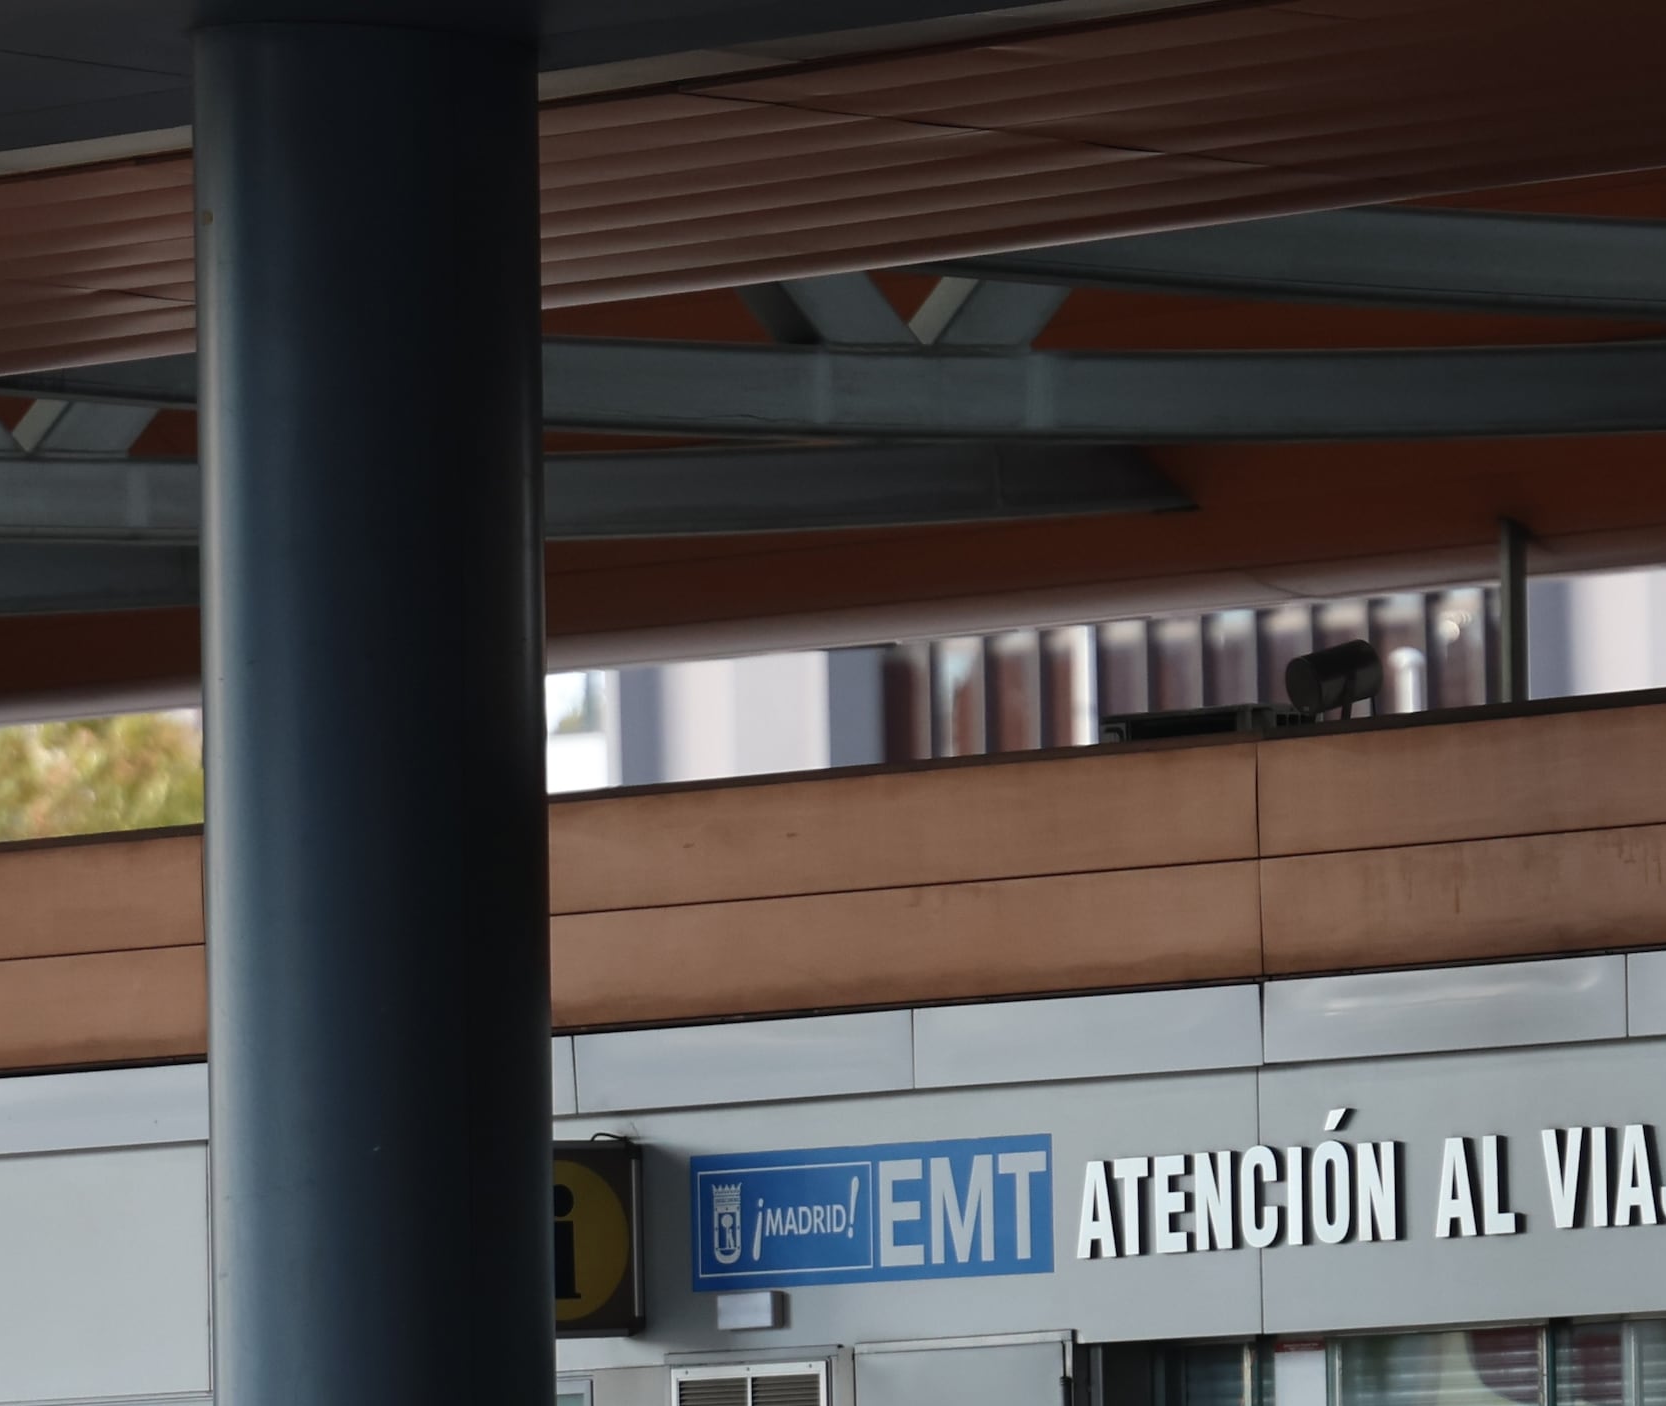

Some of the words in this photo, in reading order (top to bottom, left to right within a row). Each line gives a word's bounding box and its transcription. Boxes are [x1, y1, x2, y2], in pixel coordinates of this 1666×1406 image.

[753, 1176, 860, 1261] ¡MADRID!
[878, 1150, 1047, 1267] EMT
[1077, 1107, 1403, 1260] ATENCIÓN
[1435, 1134, 1521, 1239] AL
